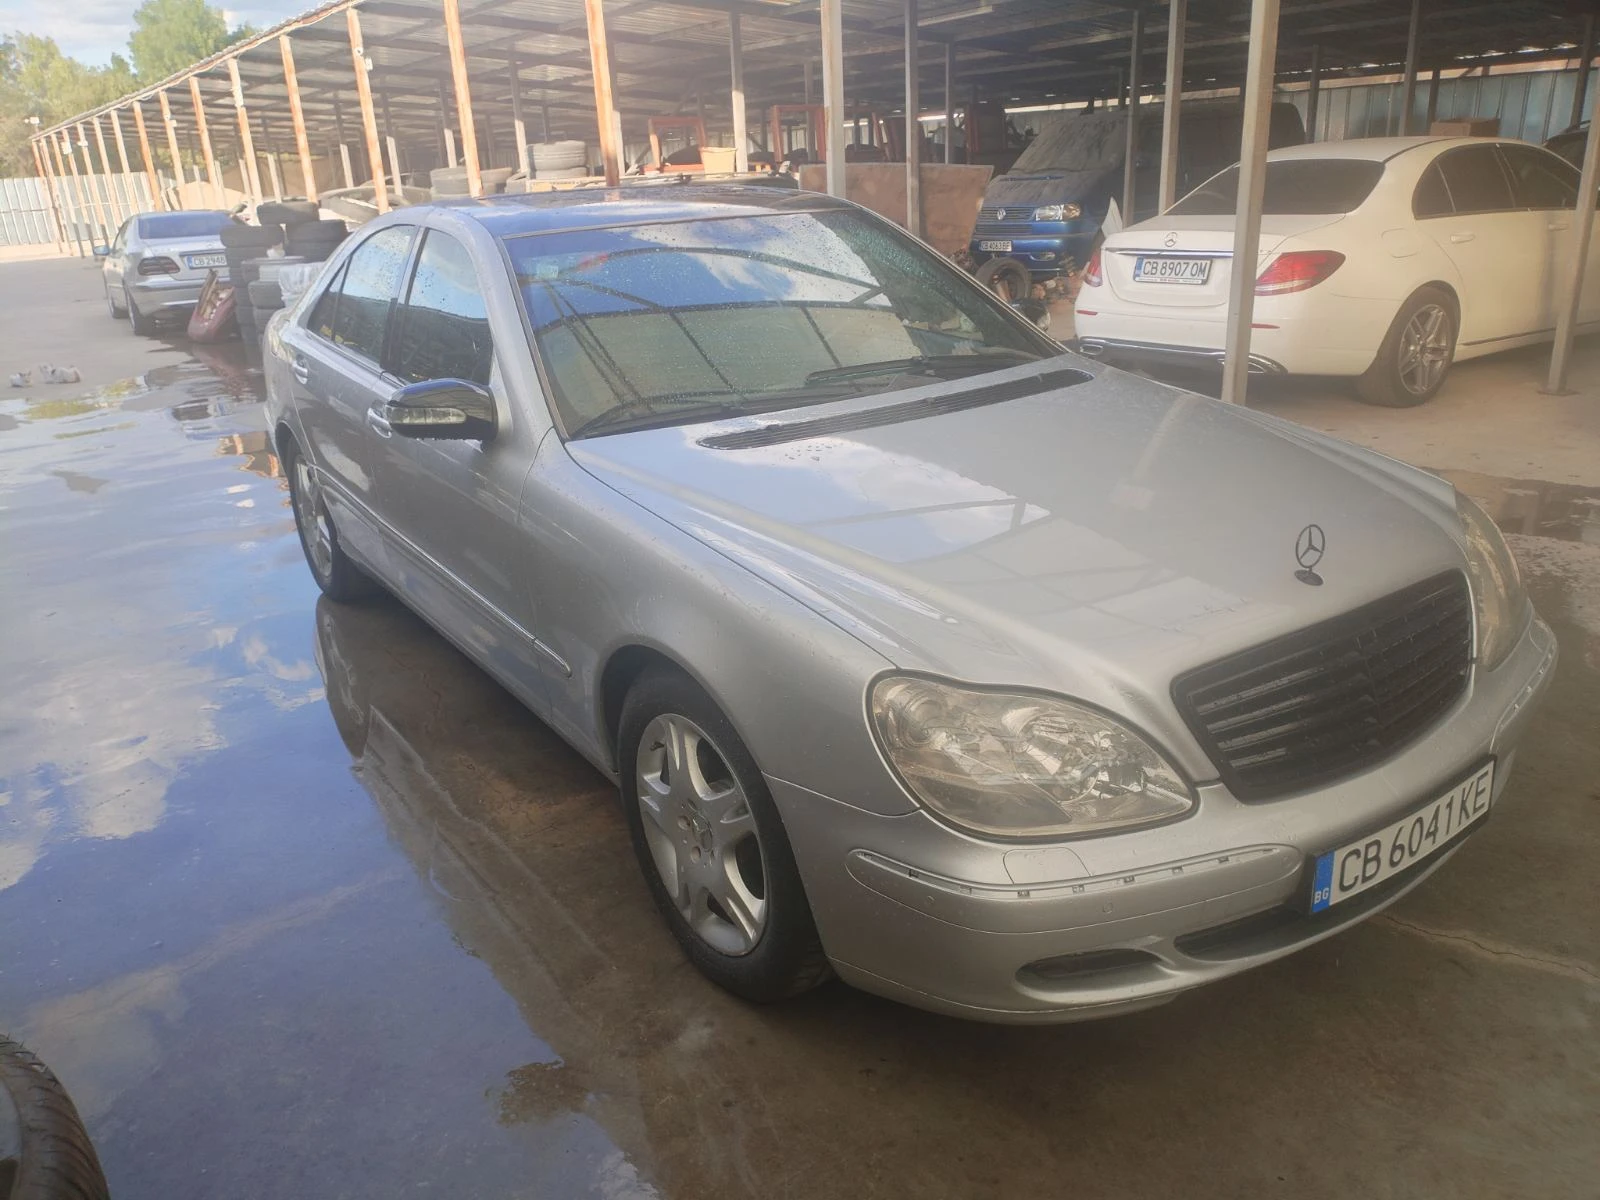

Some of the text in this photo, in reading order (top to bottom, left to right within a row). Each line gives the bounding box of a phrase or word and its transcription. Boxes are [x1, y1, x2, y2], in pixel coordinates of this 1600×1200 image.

[1143, 261, 1208, 278] CB 8907 OM
[1339, 839, 1382, 892] CB
[1314, 887, 1330, 905] BG
